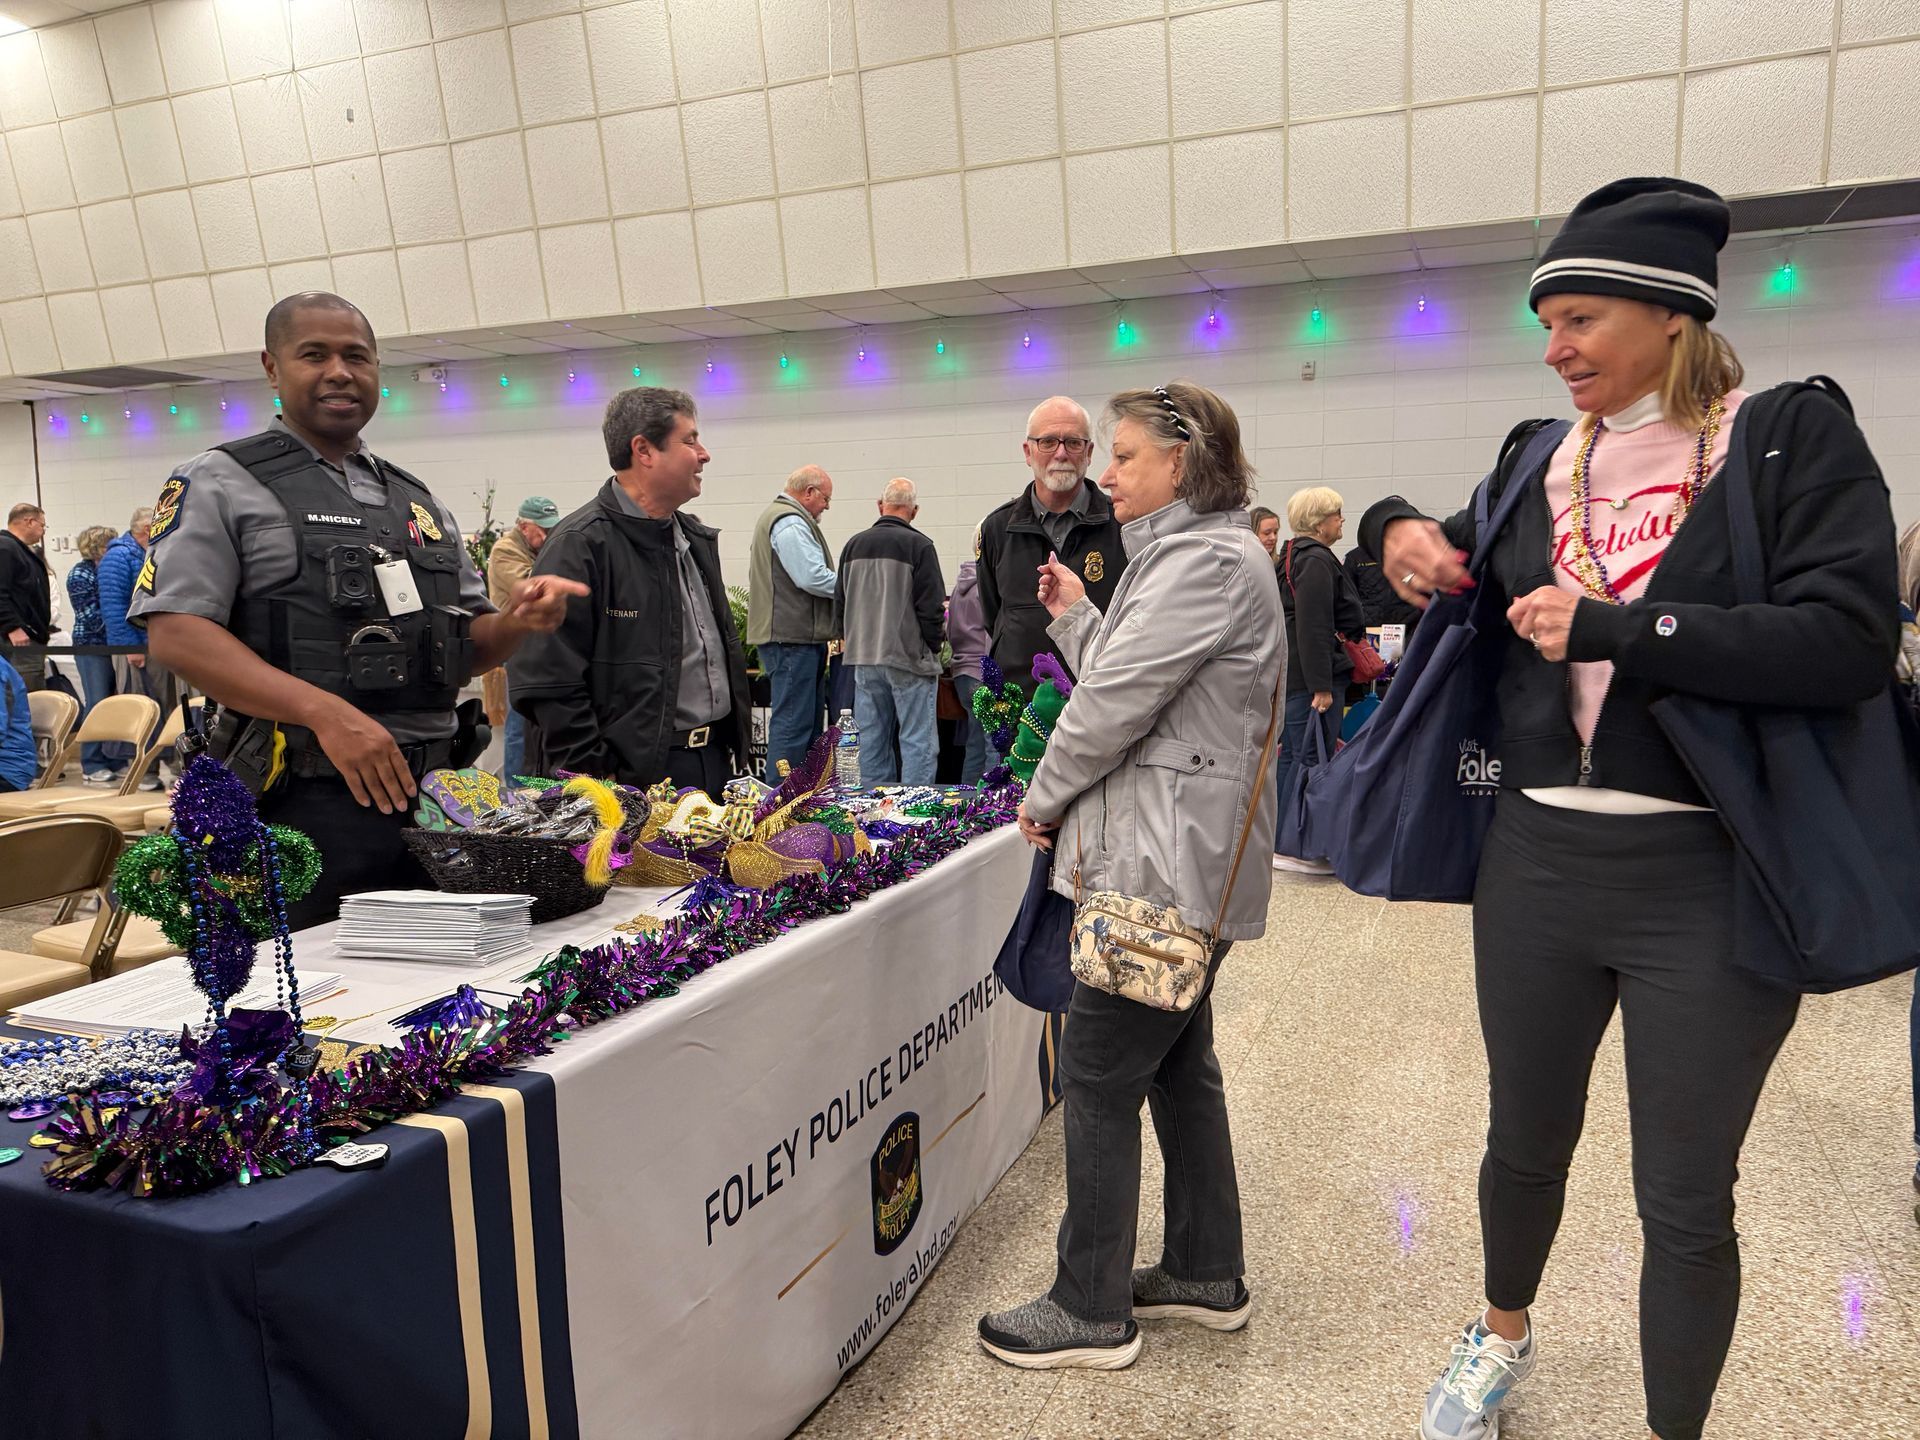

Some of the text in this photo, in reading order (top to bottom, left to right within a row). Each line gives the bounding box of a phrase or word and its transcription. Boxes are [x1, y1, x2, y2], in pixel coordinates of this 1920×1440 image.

[307, 513, 361, 525] M.NICELY
[1457, 749, 1501, 781] Fole
[705, 1126, 800, 1247] FOLEY
[809, 1056, 893, 1160] POLICE
[899, 971, 1003, 1085] DEPARTMEN
[879, 1122, 914, 1170] POLICE
[886, 1208, 911, 1241] FOLEY
[837, 1211, 960, 1369] www.foleyalpd.gov
